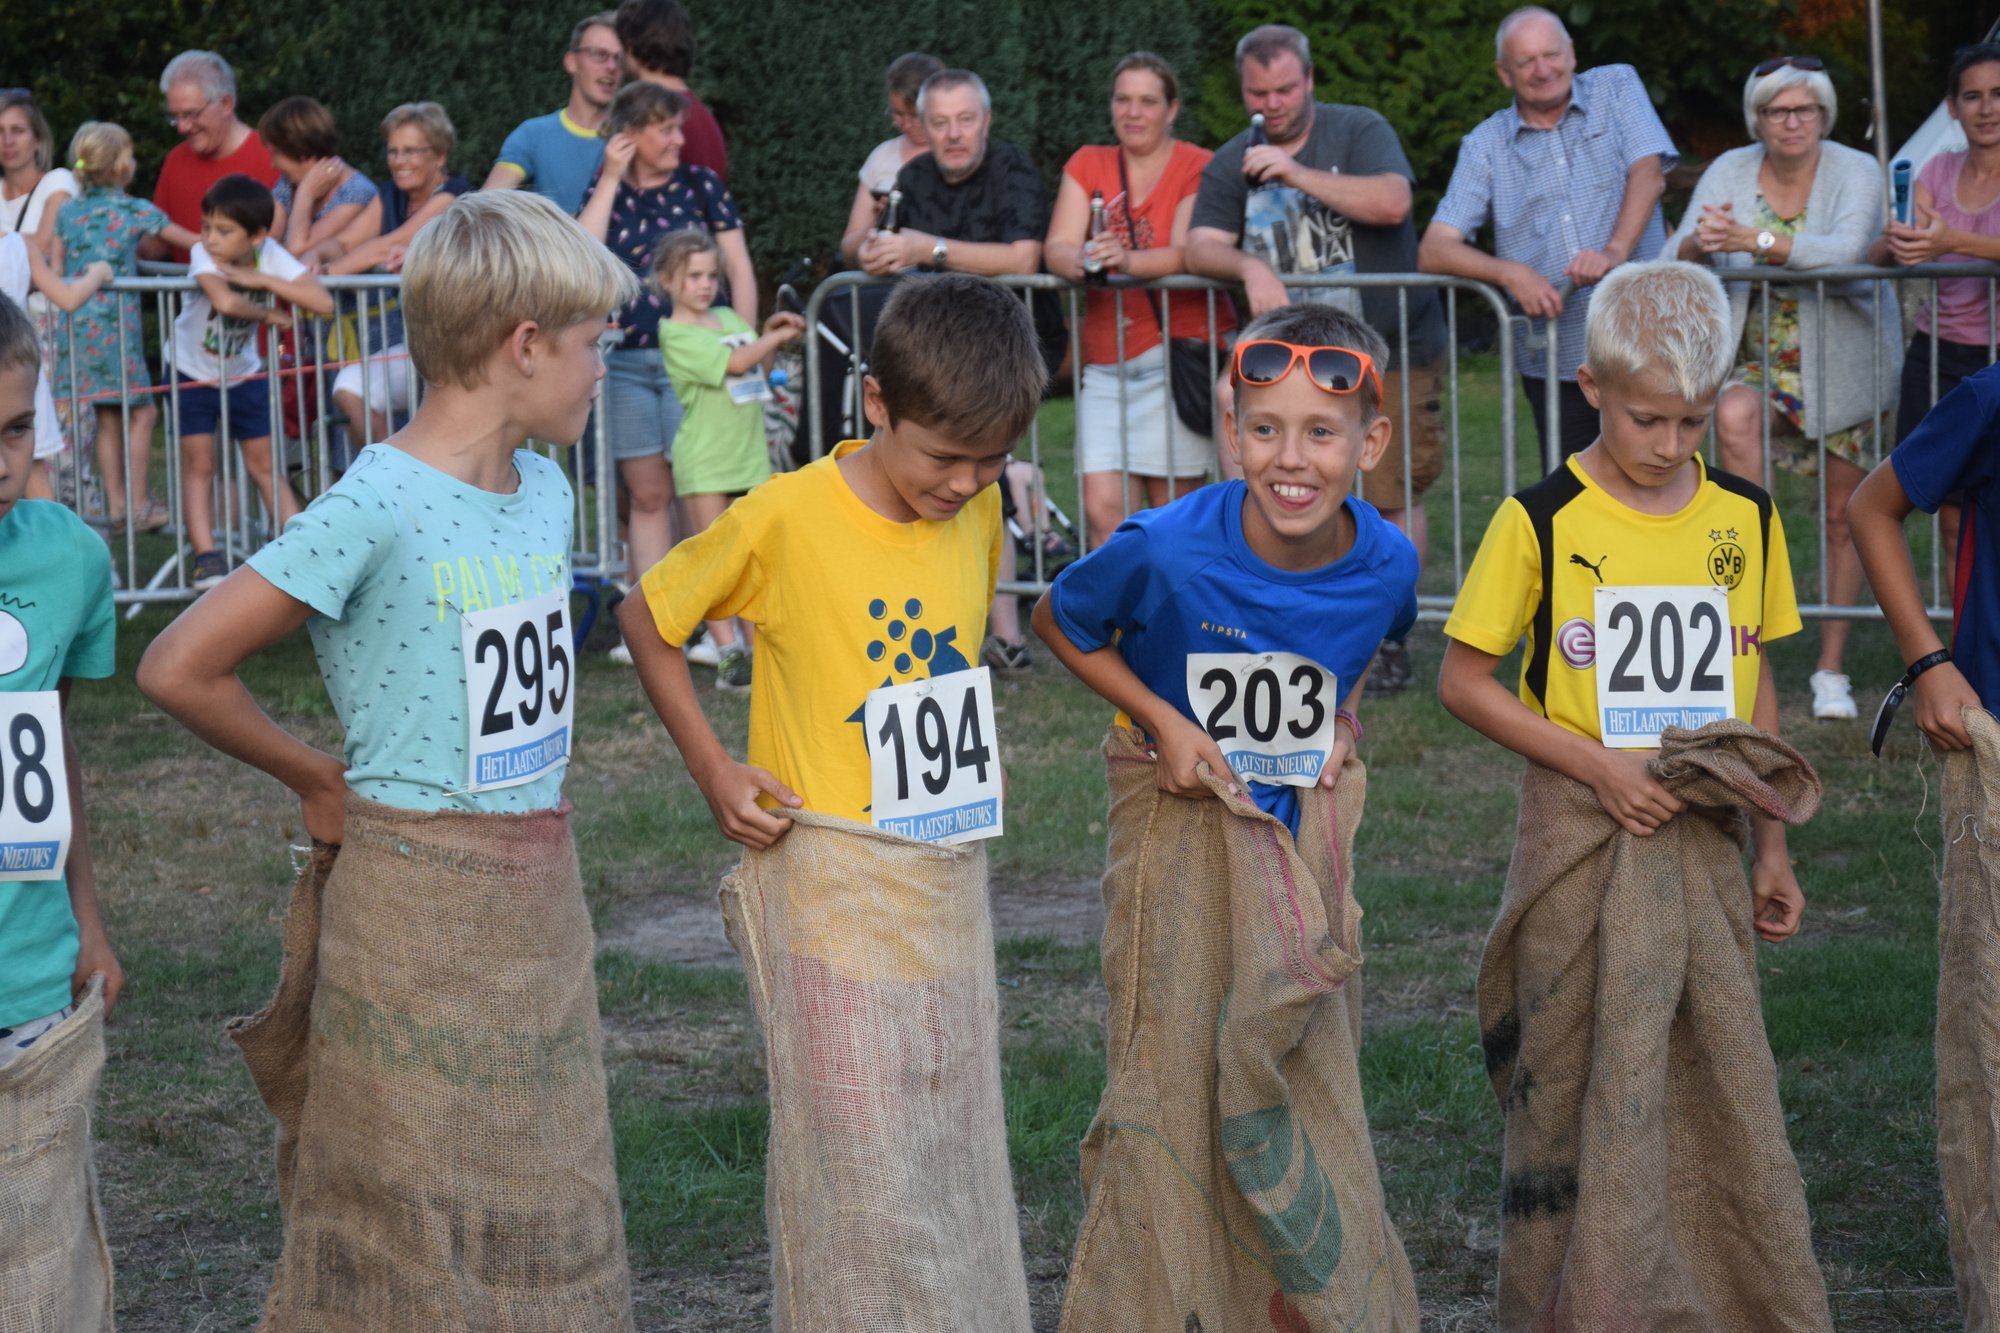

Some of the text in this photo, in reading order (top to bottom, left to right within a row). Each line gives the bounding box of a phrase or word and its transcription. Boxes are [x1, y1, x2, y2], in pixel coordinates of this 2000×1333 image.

[1713, 547, 1742, 576] BVB
[1723, 574, 1734, 585] 09
[432, 554, 526, 624] PALM
[1201, 621, 1248, 640] KIPSTA
[1608, 600, 1724, 693] 202
[475, 609, 570, 737] 295
[1200, 664, 1325, 743] 203
[1609, 710, 1632, 733] HET
[481, 733, 565, 782] HET LAATSTE NIEUWS
[878, 686, 991, 801] 194
[1276, 755, 1319, 775] NIEUWS
[0, 712, 54, 824] 8
[909, 813, 954, 841] LAATSTE
[954, 804, 992, 832] NIEUWS
[0, 846, 52, 870] NIEUWS
